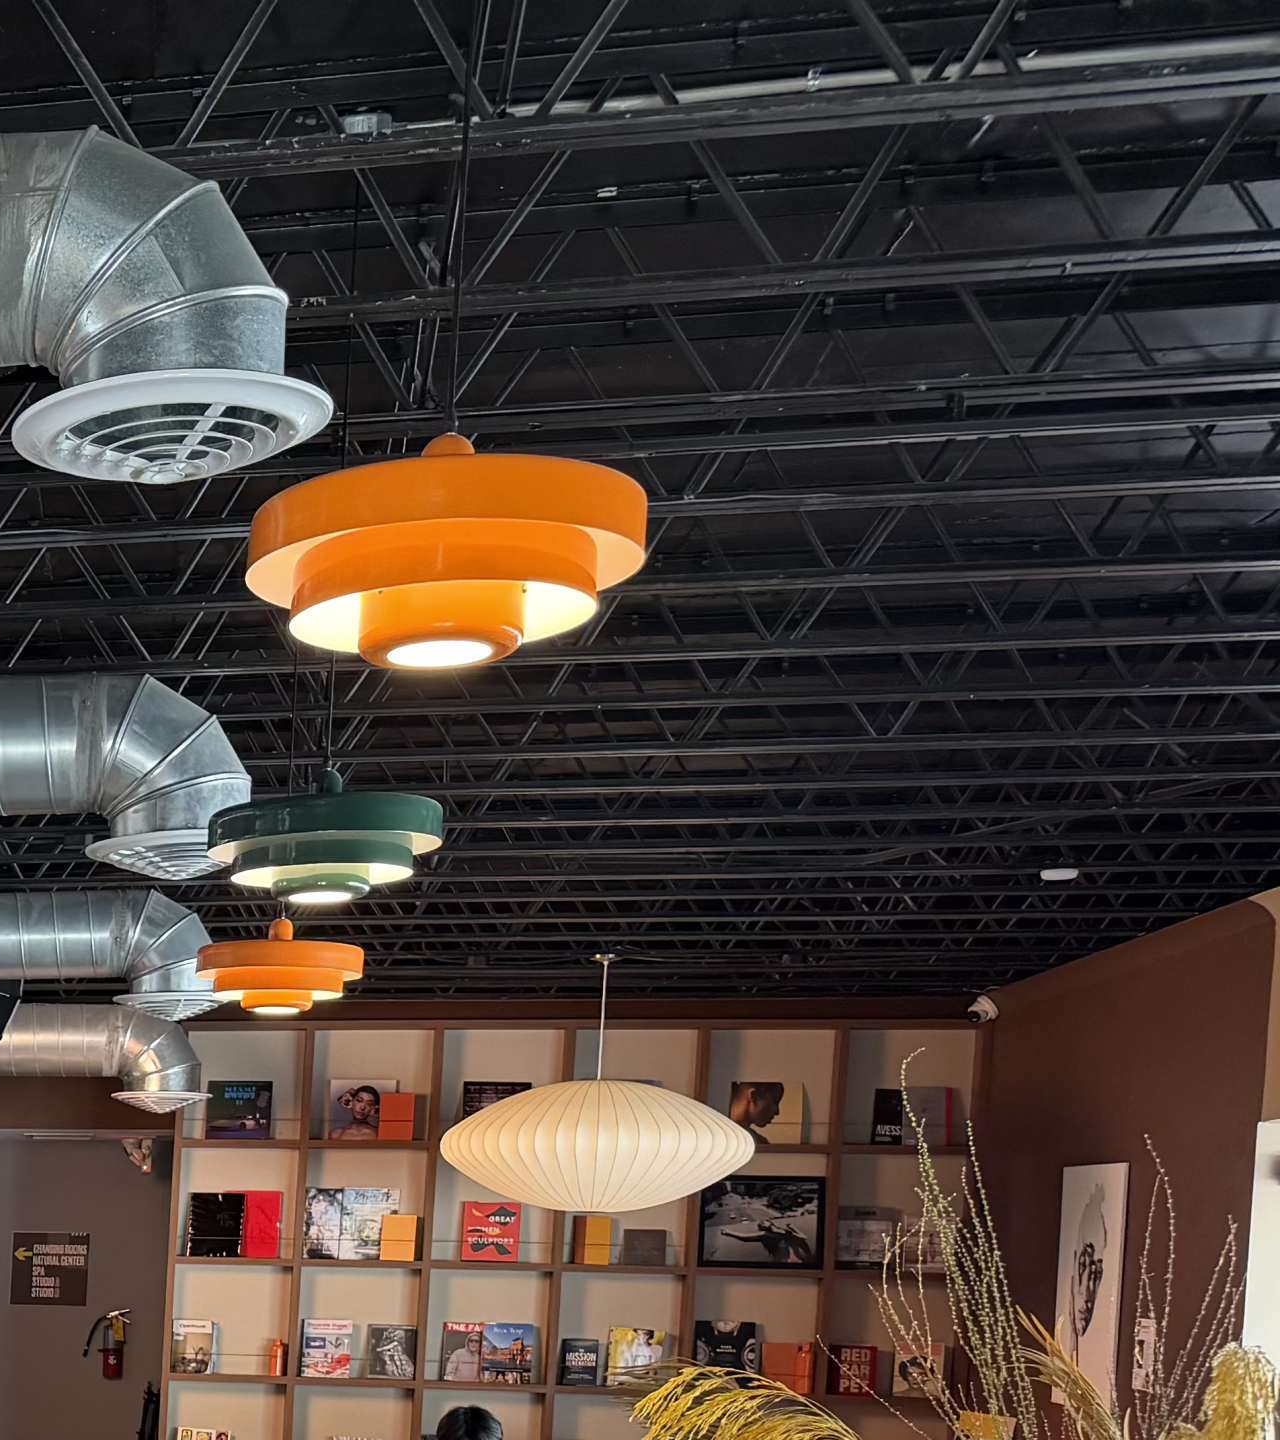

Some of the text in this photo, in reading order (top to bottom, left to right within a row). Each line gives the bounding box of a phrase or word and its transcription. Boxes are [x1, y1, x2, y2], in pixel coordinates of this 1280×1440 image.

[488, 1215, 515, 1223] GREAT
[467, 1237, 514, 1245] SCULPTORS
[32, 1266, 45, 1276] SPA
[31, 1276, 55, 1287] STUDIO
[31, 1287, 54, 1298] STUDIO
[467, 1323, 481, 1332] FA
[565, 1352, 597, 1361] MISSION
[840, 1348, 871, 1361] RED
